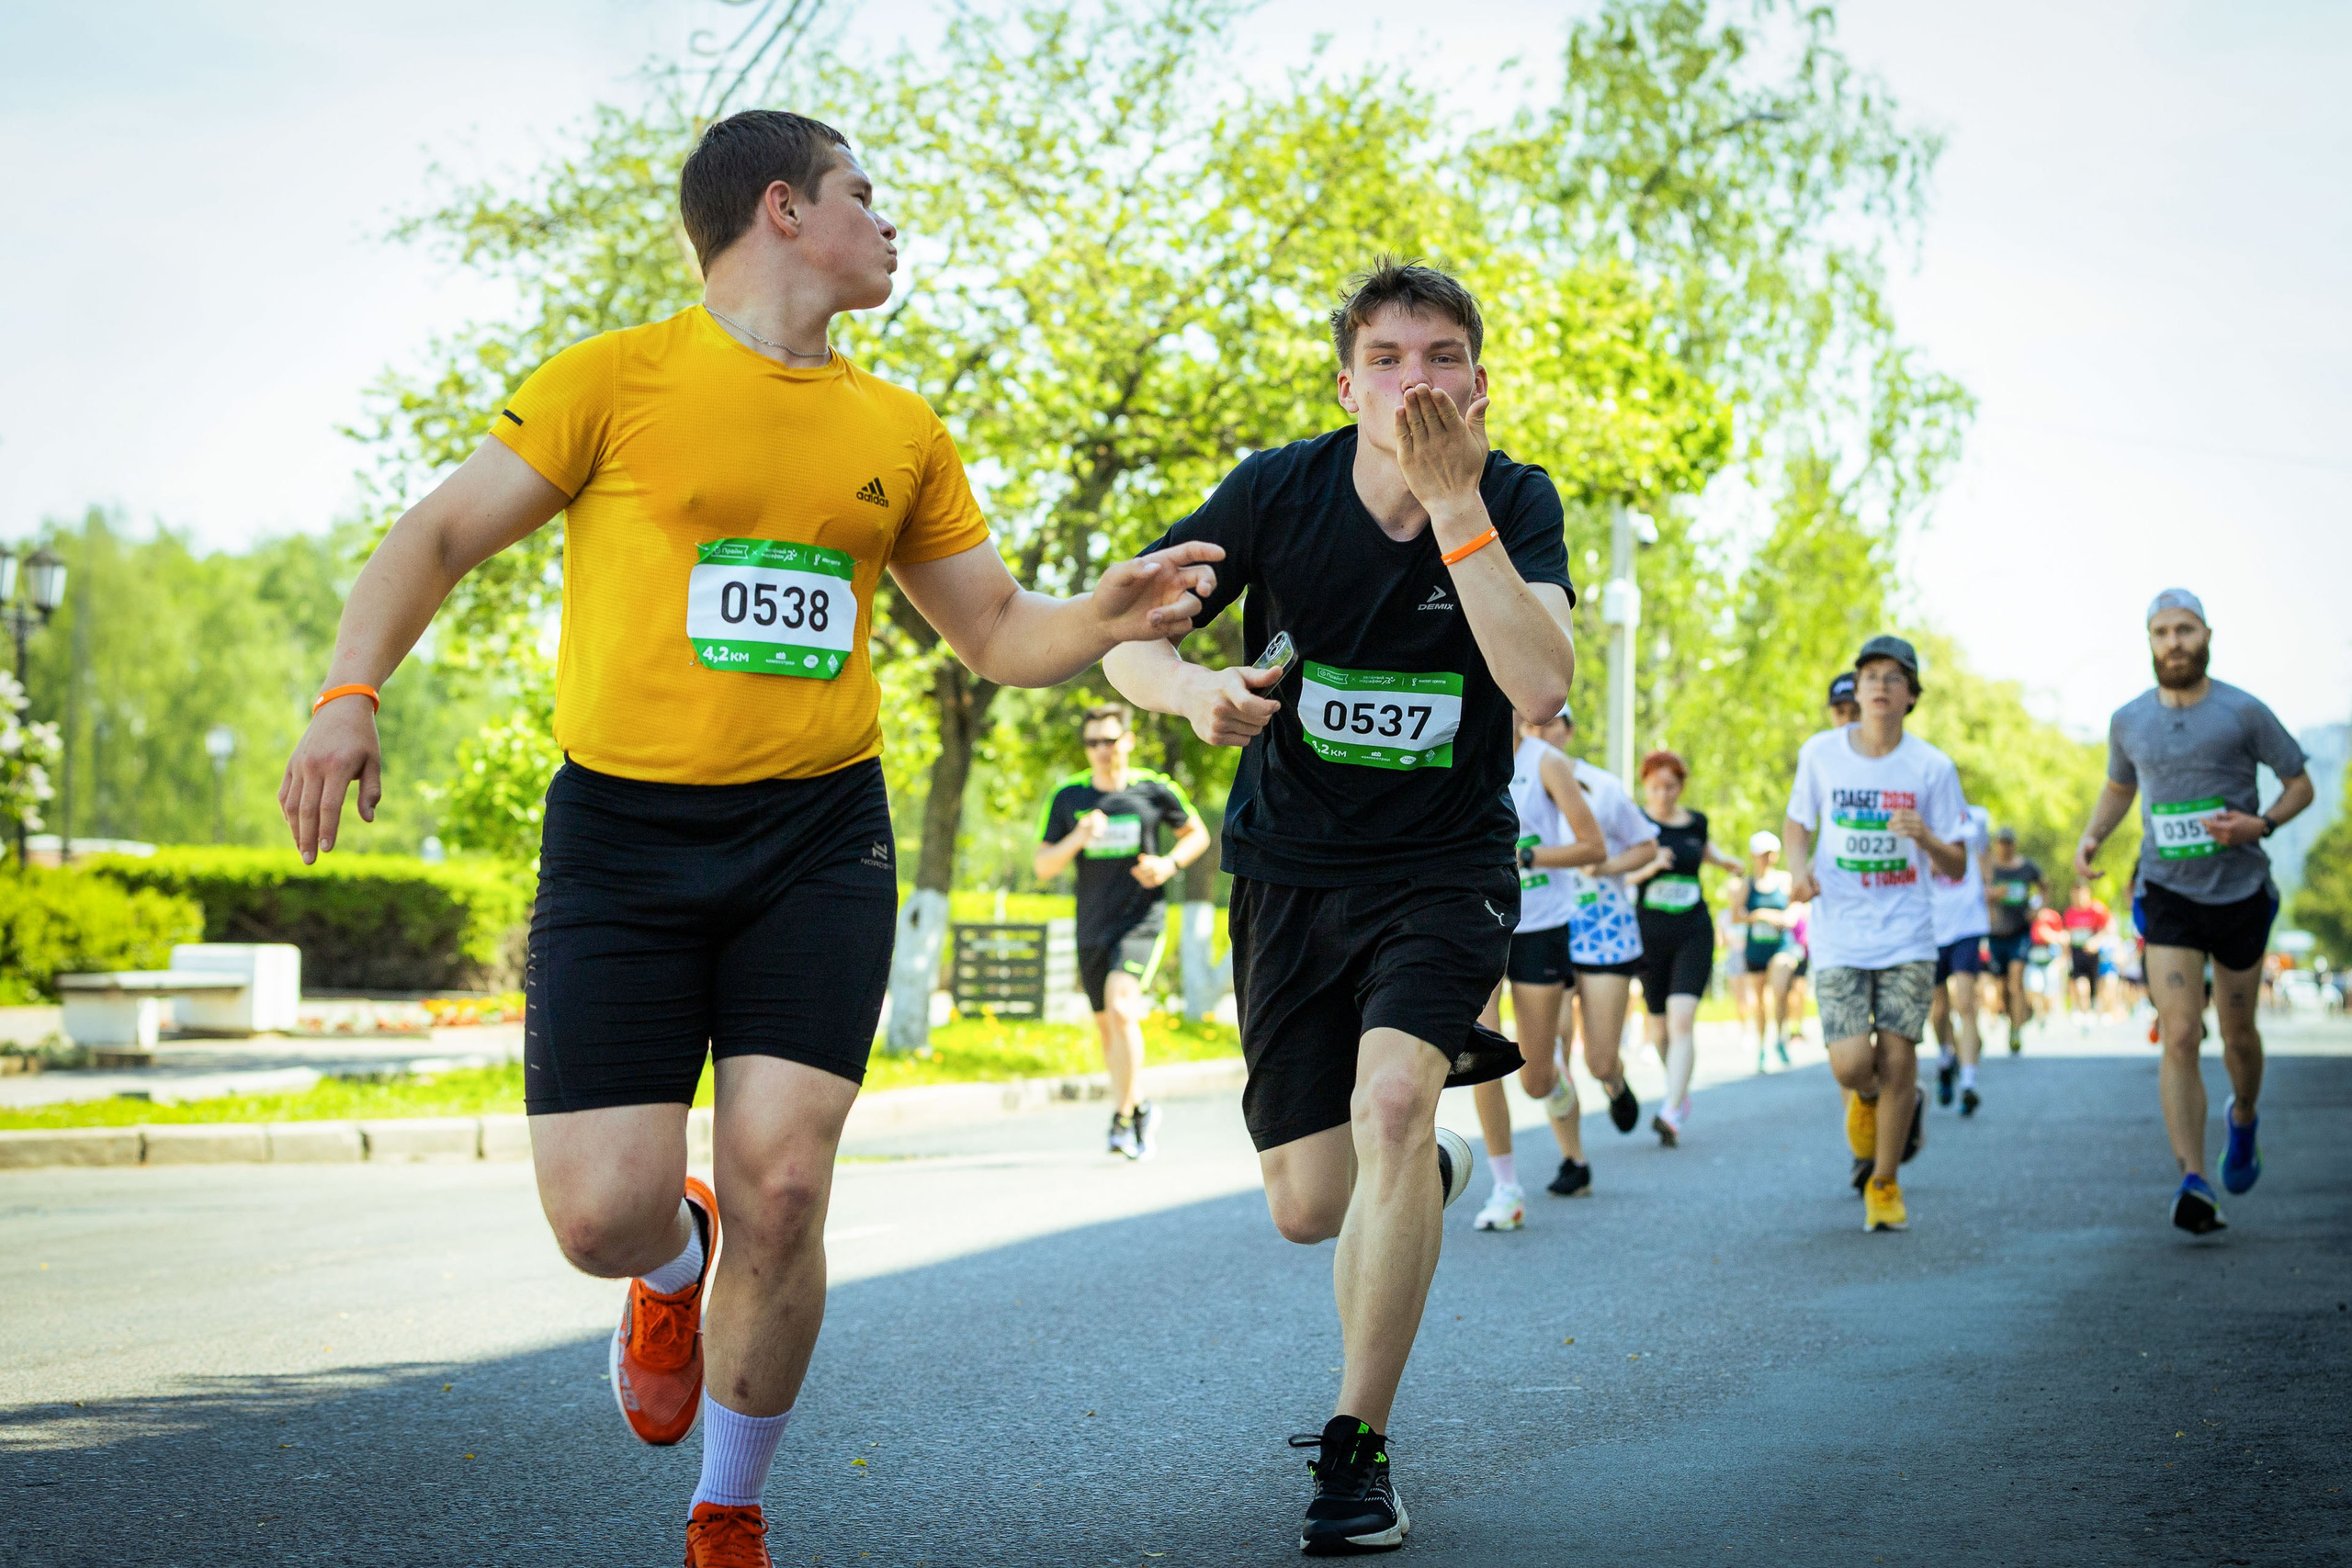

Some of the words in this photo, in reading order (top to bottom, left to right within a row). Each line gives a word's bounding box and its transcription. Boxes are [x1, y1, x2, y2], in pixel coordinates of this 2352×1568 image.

[856, 491, 889, 508] adidas
[720, 581, 830, 633] 0538
[702, 645, 729, 663] 4,2
[1323, 700, 1432, 740] 0537
[2163, 818, 2210, 840] 035
[1846, 835, 1897, 855] 0023
